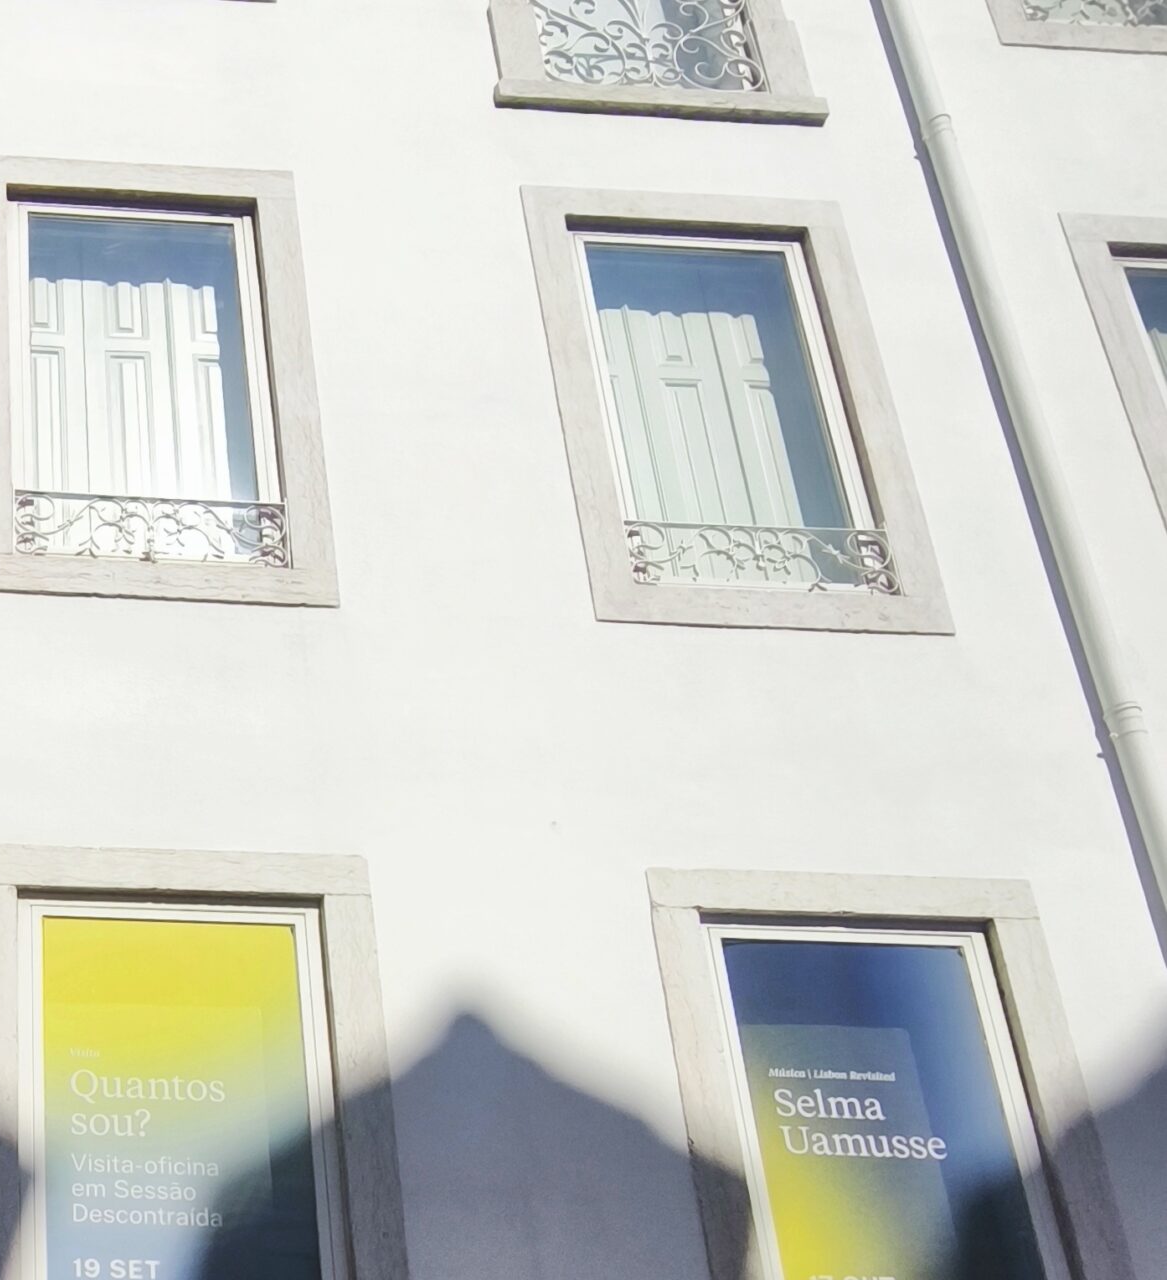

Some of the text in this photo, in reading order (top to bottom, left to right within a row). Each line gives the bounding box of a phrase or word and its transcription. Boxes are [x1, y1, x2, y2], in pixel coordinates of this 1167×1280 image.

[70, 1069, 226, 1104] Quantos
[774, 1088, 886, 1121] Selma
[71, 1109, 151, 1138] sou?
[779, 1125, 948, 1160] Uamusse
[71, 1153, 220, 1177] Visita-oficina
[72, 1179, 196, 1201] em Sessão
[72, 1203, 223, 1228] Descontraída
[73, 1258, 160, 1280] 19 SET
